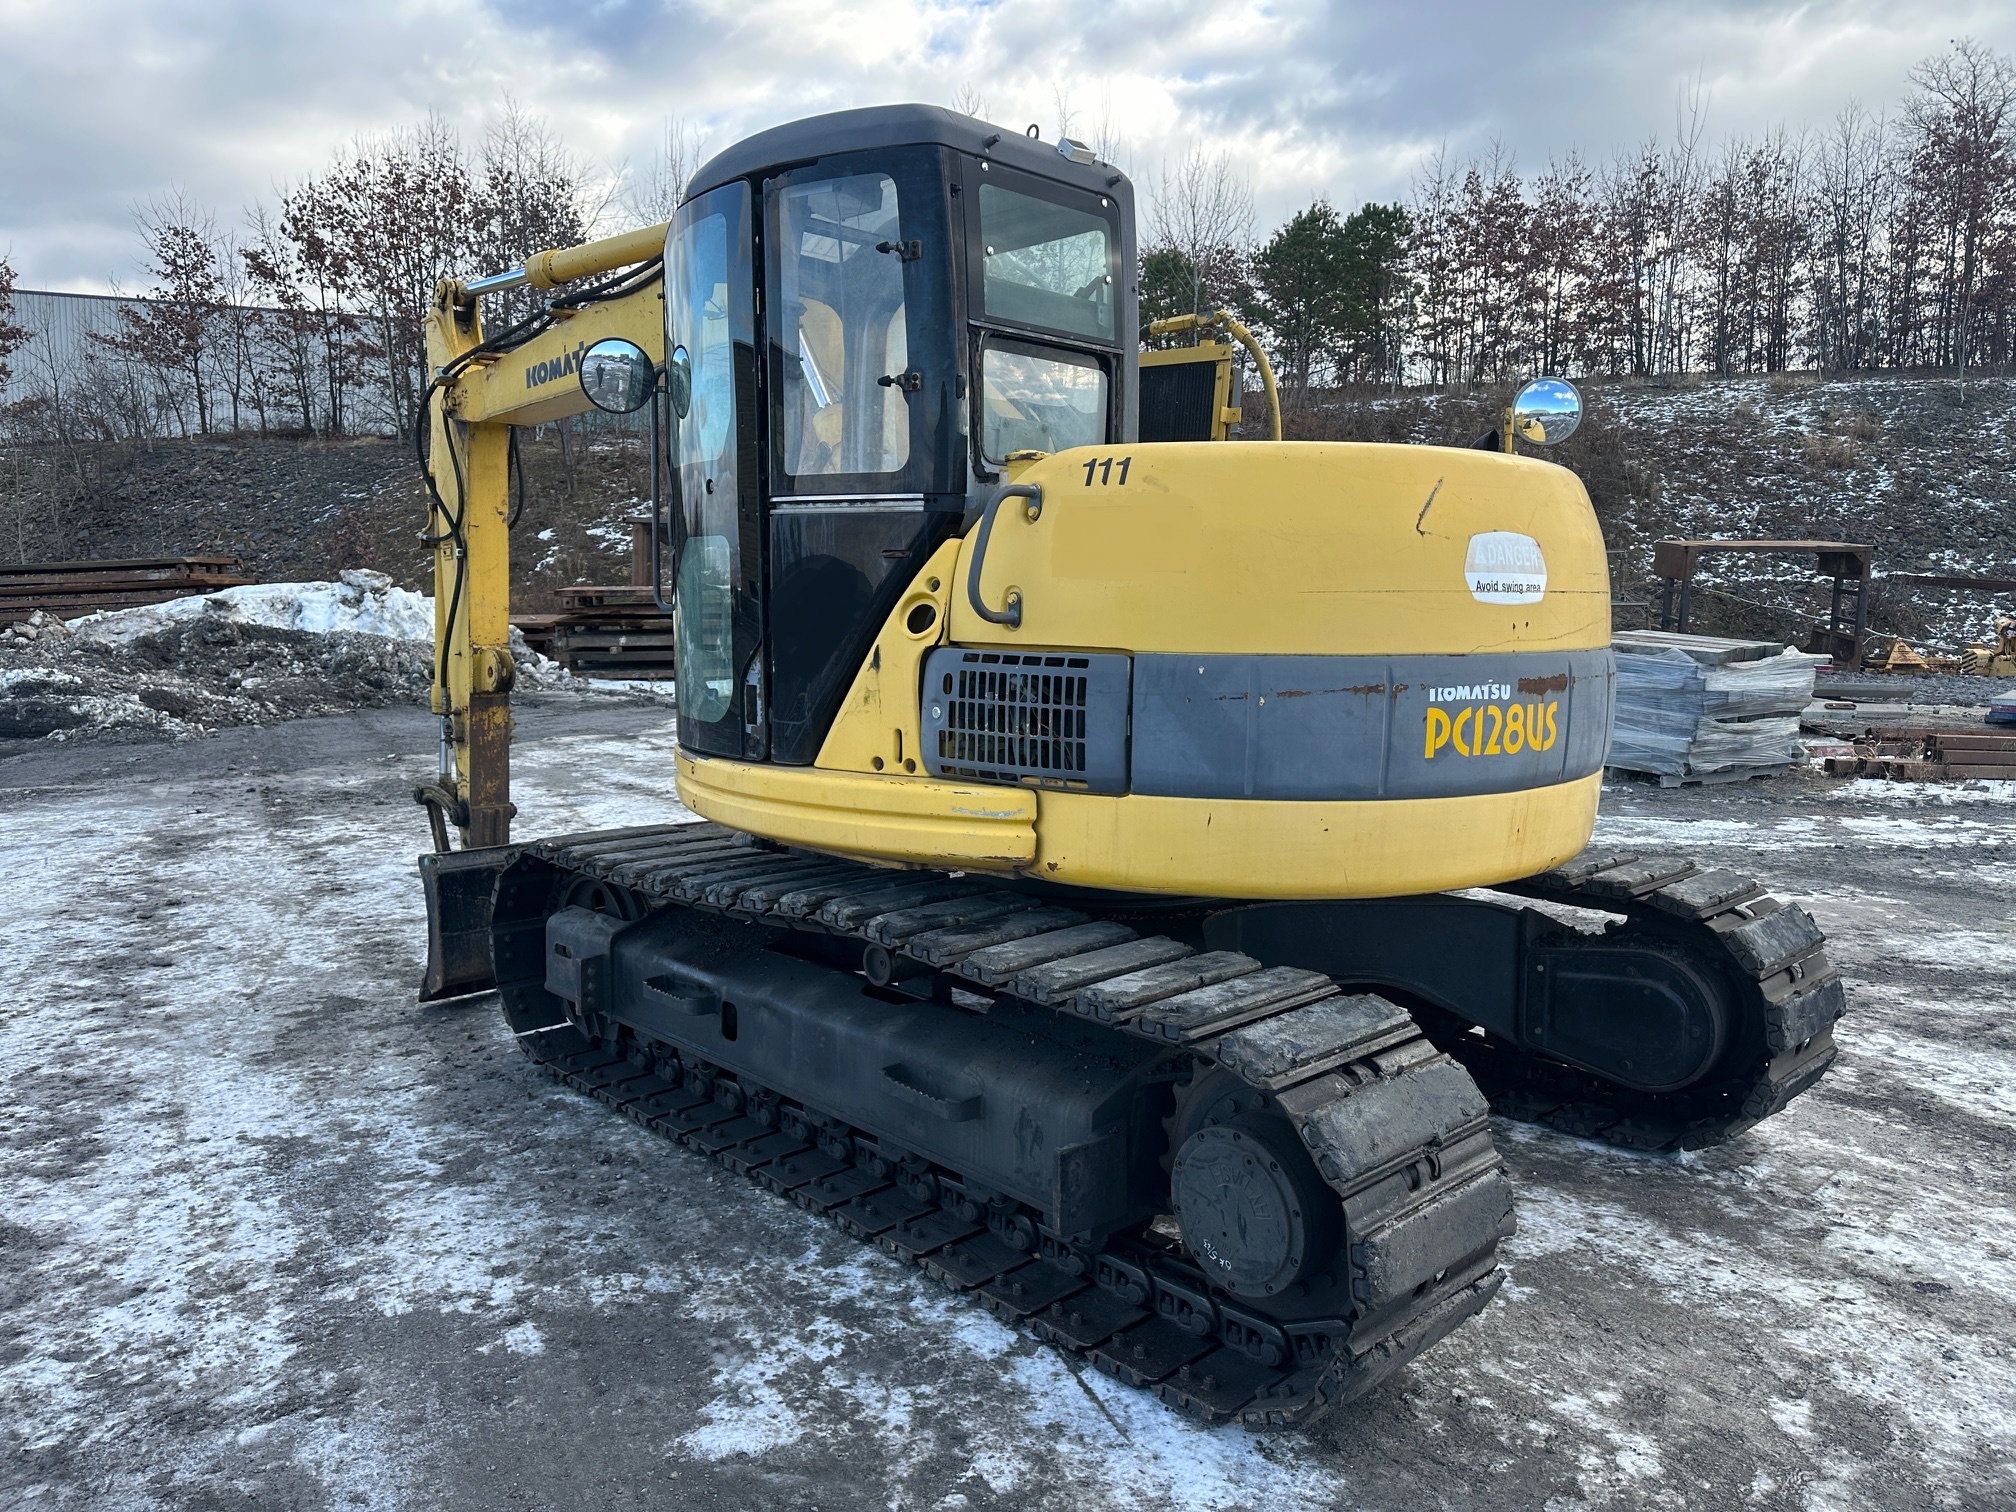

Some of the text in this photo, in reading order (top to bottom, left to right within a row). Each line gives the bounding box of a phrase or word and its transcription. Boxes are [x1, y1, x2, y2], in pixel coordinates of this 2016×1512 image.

[1083, 457, 1132, 486] 111
[1487, 544, 1539, 567] DANGER
[1476, 580, 1541, 594] Avoid swing area
[1429, 680, 1511, 702] KOMATSU
[1424, 701, 1558, 759] PC128US
